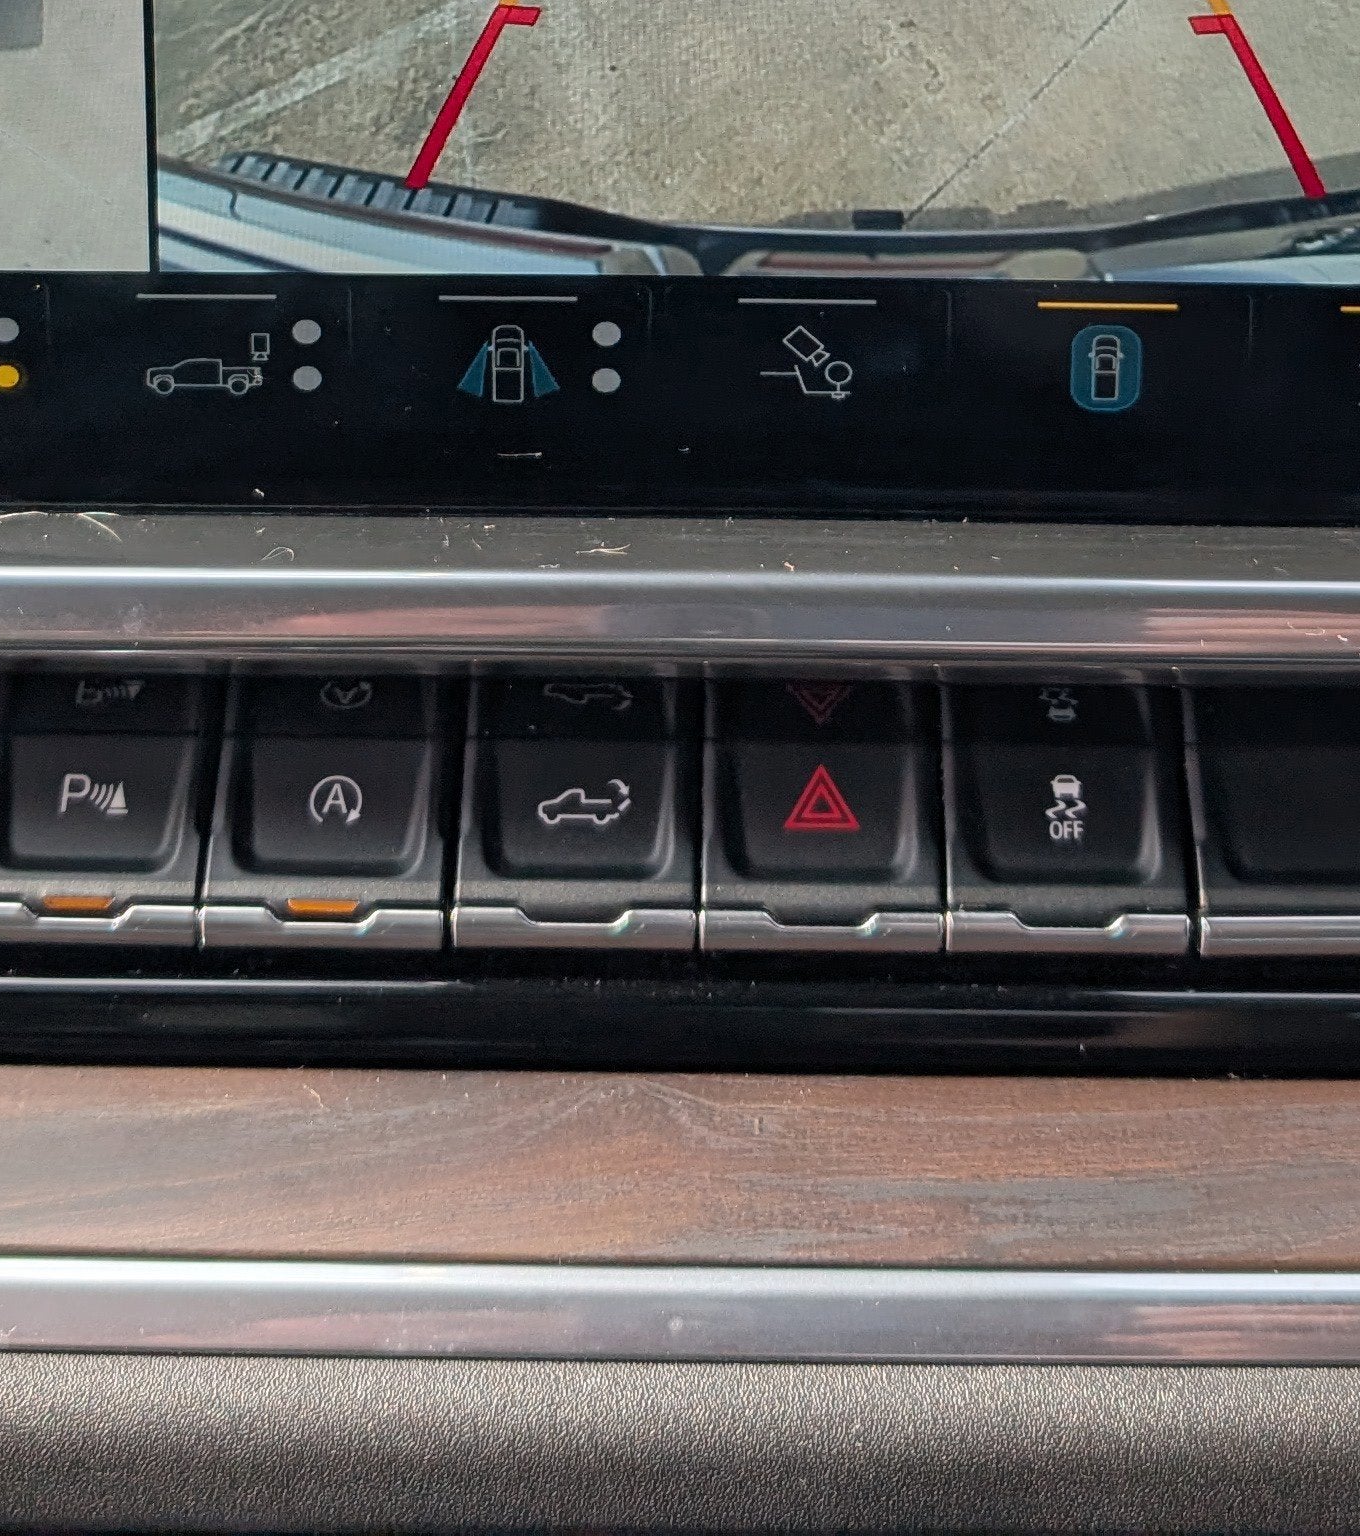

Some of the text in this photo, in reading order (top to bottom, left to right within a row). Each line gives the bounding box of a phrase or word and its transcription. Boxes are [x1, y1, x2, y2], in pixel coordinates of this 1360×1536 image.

[60, 773, 92, 813] P
[321, 783, 348, 814] A
[1049, 820, 1084, 840] OFF
